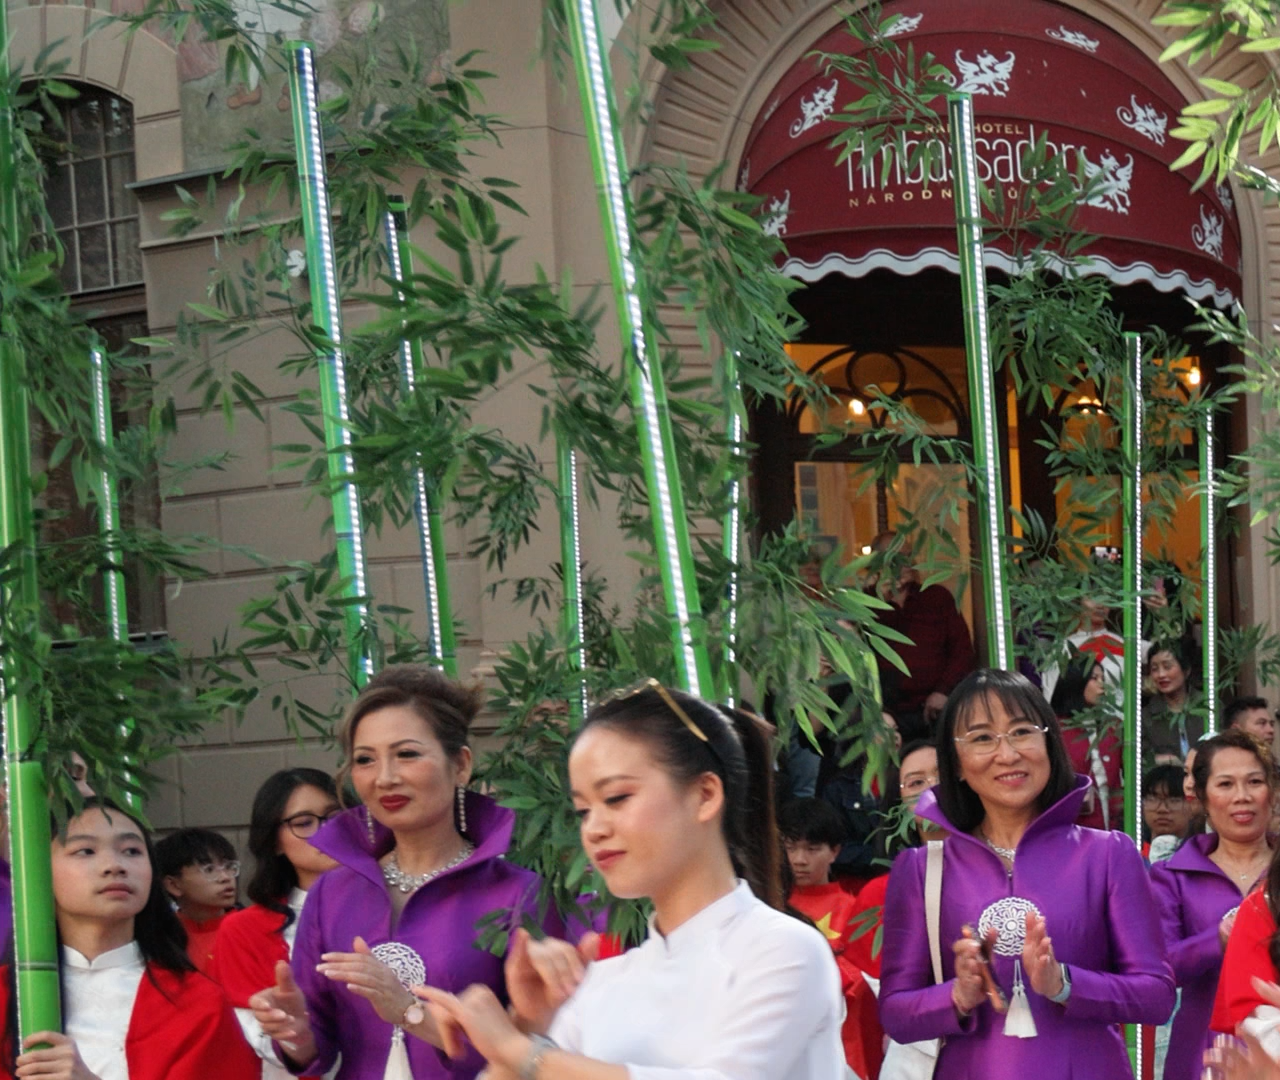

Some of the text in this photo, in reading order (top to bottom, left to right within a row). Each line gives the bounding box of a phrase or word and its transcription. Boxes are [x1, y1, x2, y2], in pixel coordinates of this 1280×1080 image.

[974, 122, 1024, 135] HOTEL
[847, 124, 1076, 191] Ambasador
[849, 188, 952, 207] NÁRODN
